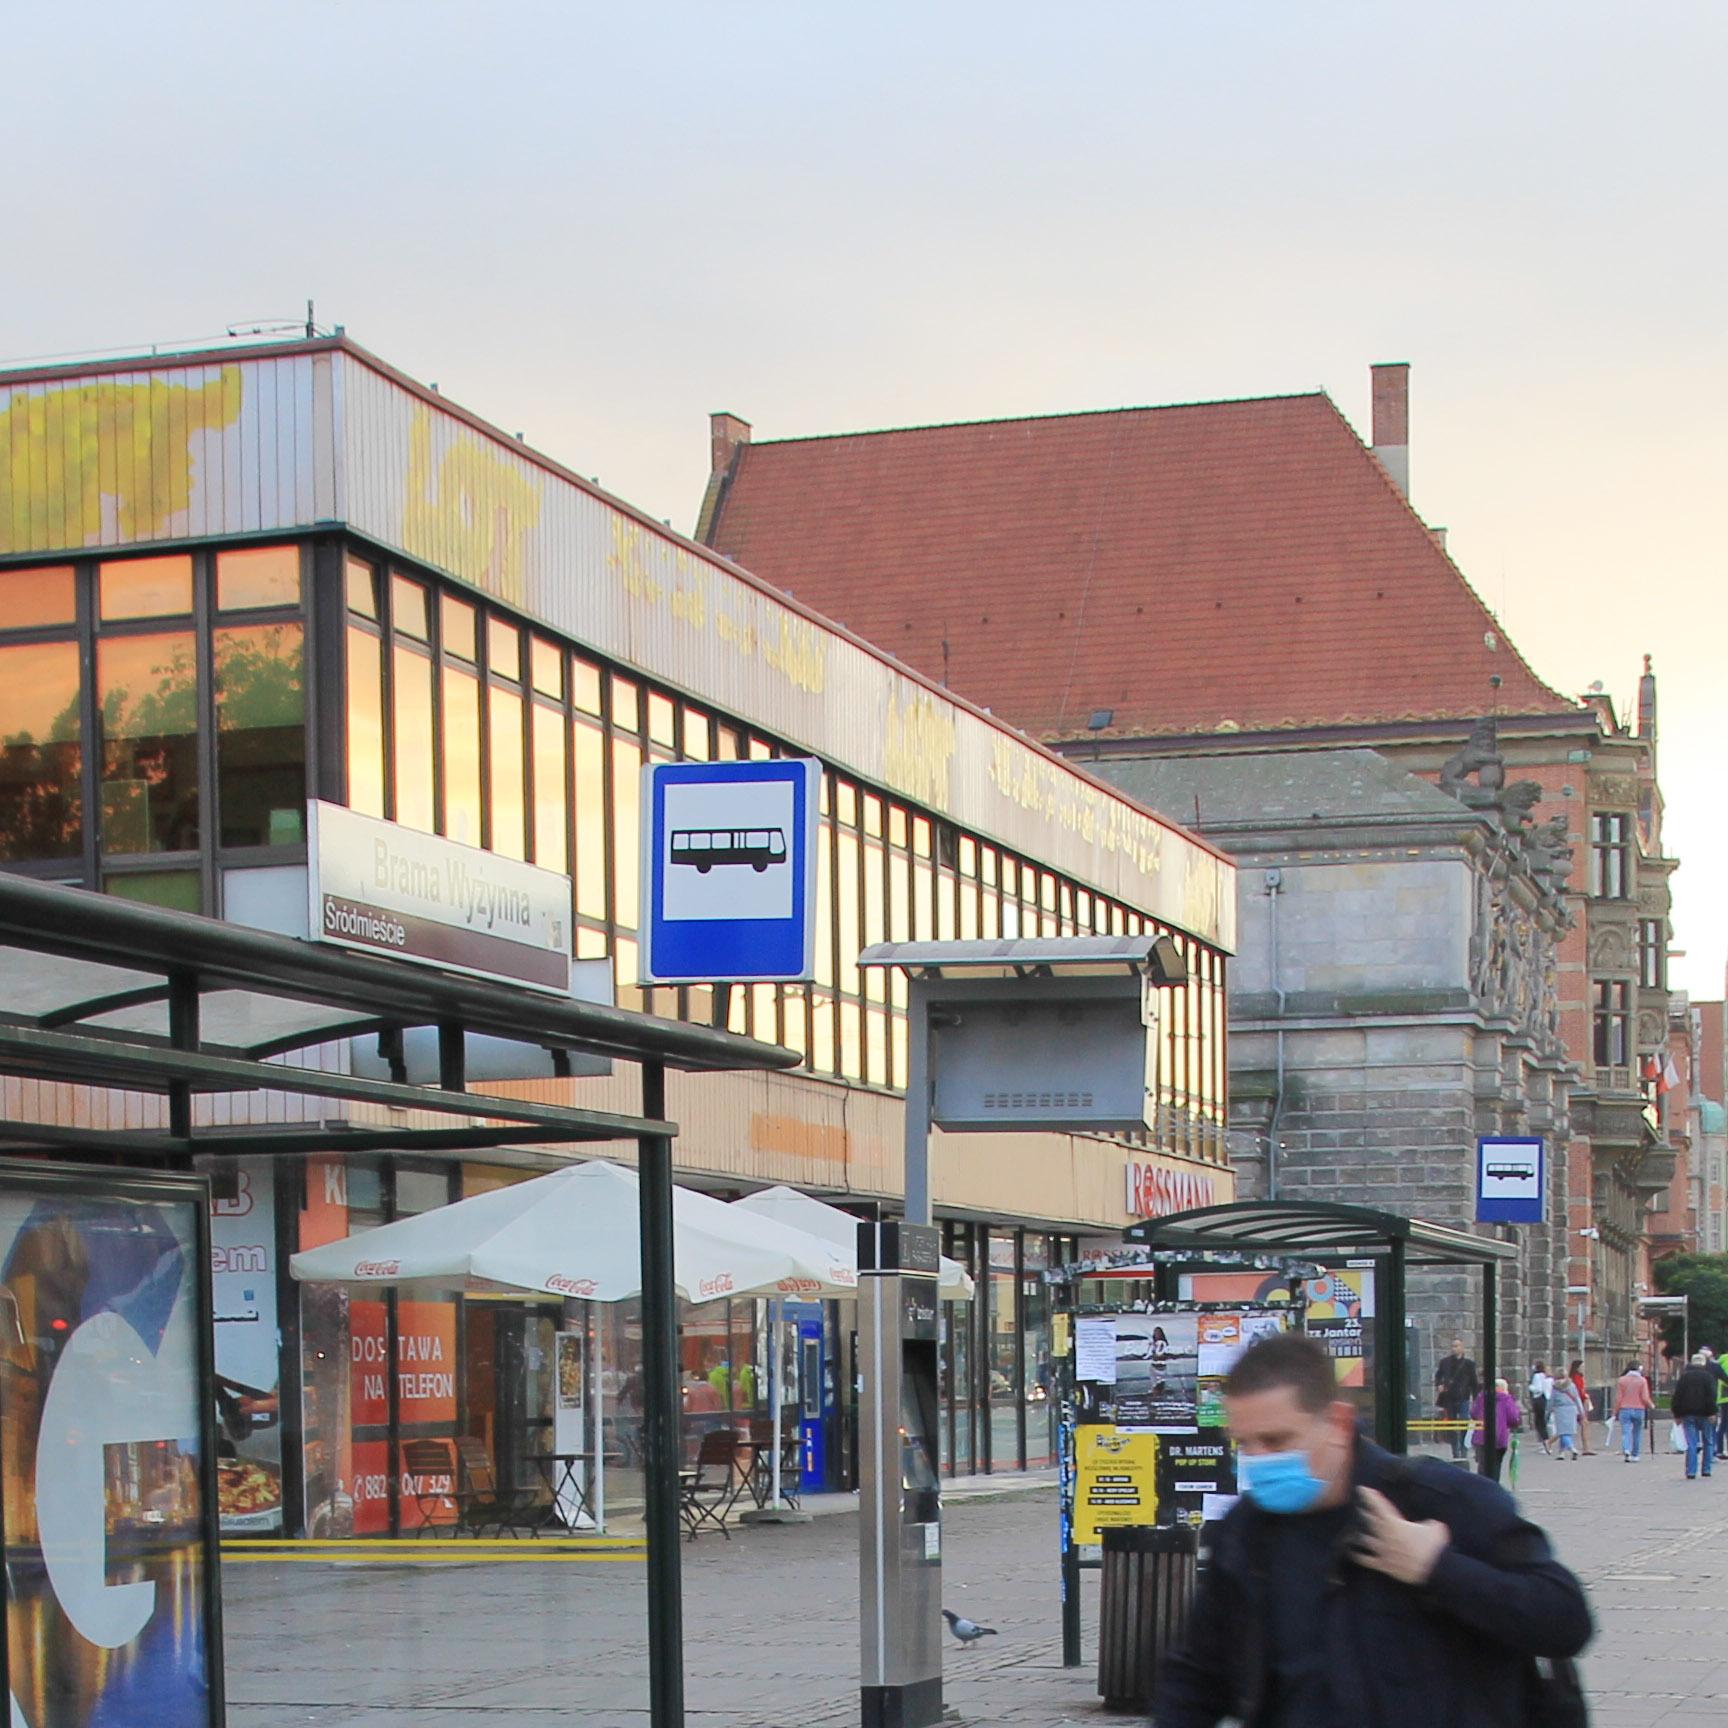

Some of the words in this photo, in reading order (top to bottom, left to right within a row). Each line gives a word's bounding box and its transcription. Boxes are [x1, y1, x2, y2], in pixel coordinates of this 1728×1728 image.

[374, 837, 441, 902] Brama
[446, 860, 531, 929] Wyżynna
[325, 895, 406, 947] Śródmieście
[1129, 1162, 1216, 1218] ROSSMANN
[1324, 1328, 1362, 1338] Jantar
[364, 1374, 385, 1400] NA
[398, 1373, 454, 1398] TELEFON
[1185, 1446, 1224, 1456] MARTENS
[365, 1474, 387, 1499] 882
